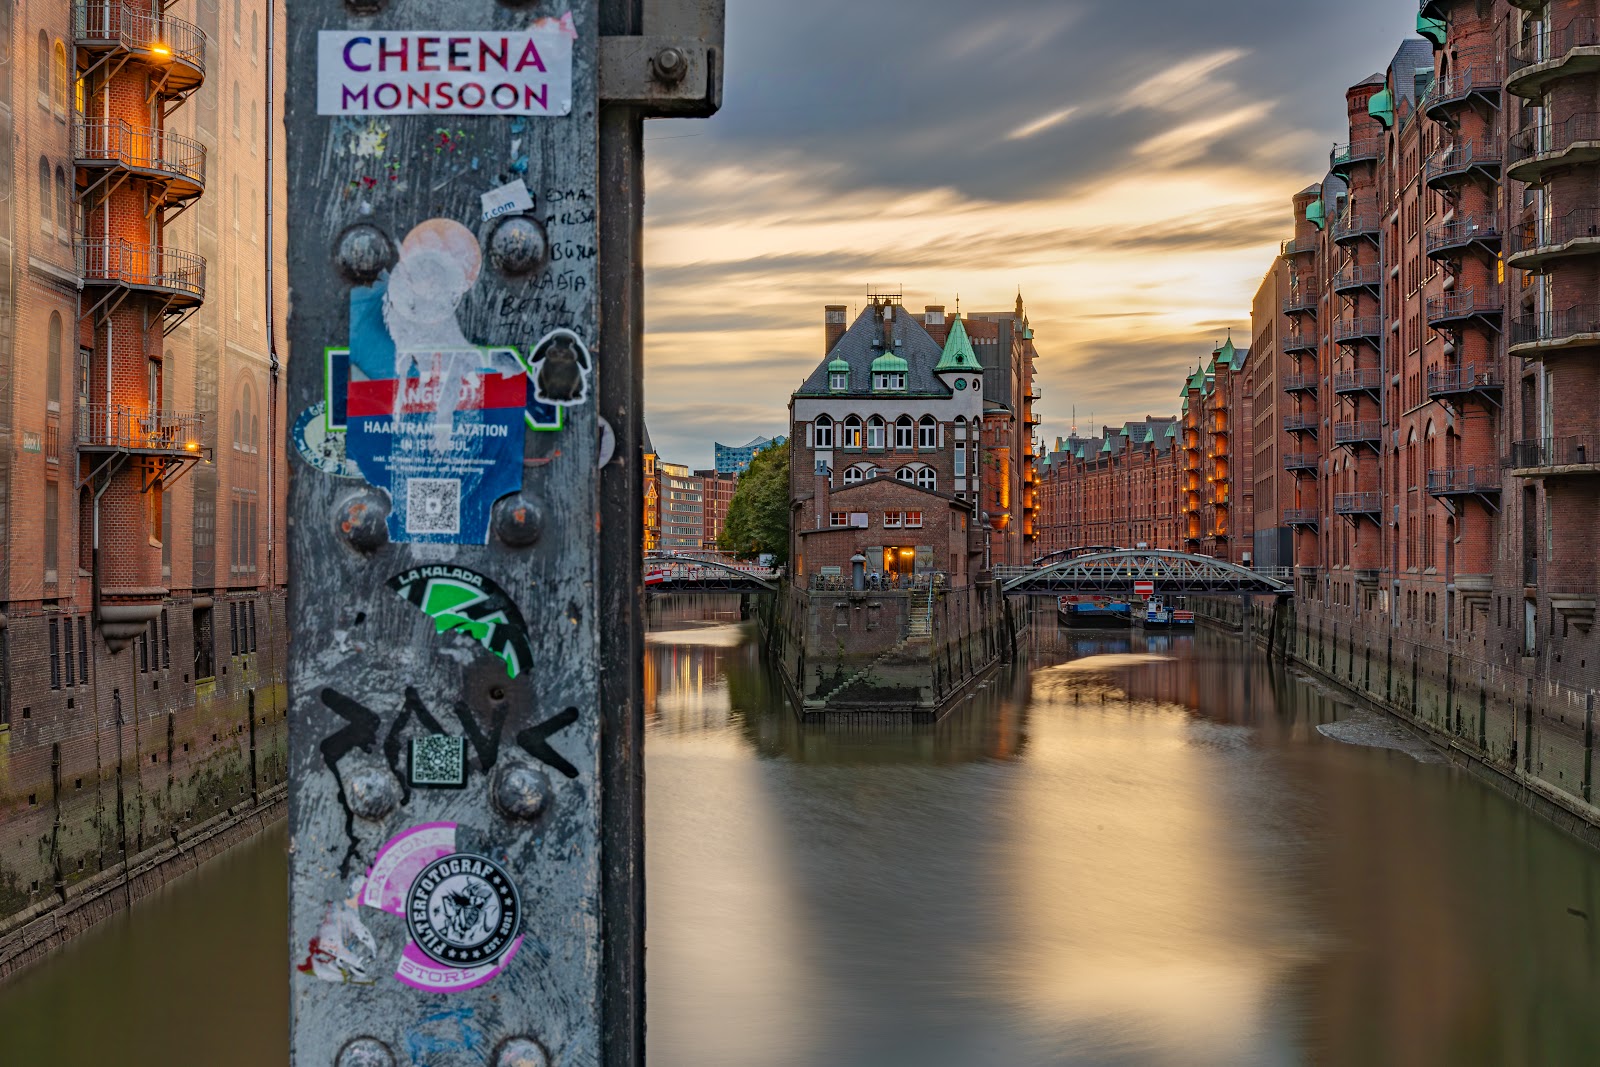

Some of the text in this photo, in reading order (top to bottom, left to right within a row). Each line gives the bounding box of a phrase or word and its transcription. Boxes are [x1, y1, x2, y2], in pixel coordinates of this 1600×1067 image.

[342, 36, 547, 72] CHEENA
[341, 82, 548, 111] MONSOON
[399, 566, 483, 587] LA KALADA
[413, 859, 494, 956] FILTERFOTOGRAF
[483, 911, 513, 955] EST. 2021
[401, 961, 475, 983] STORE
